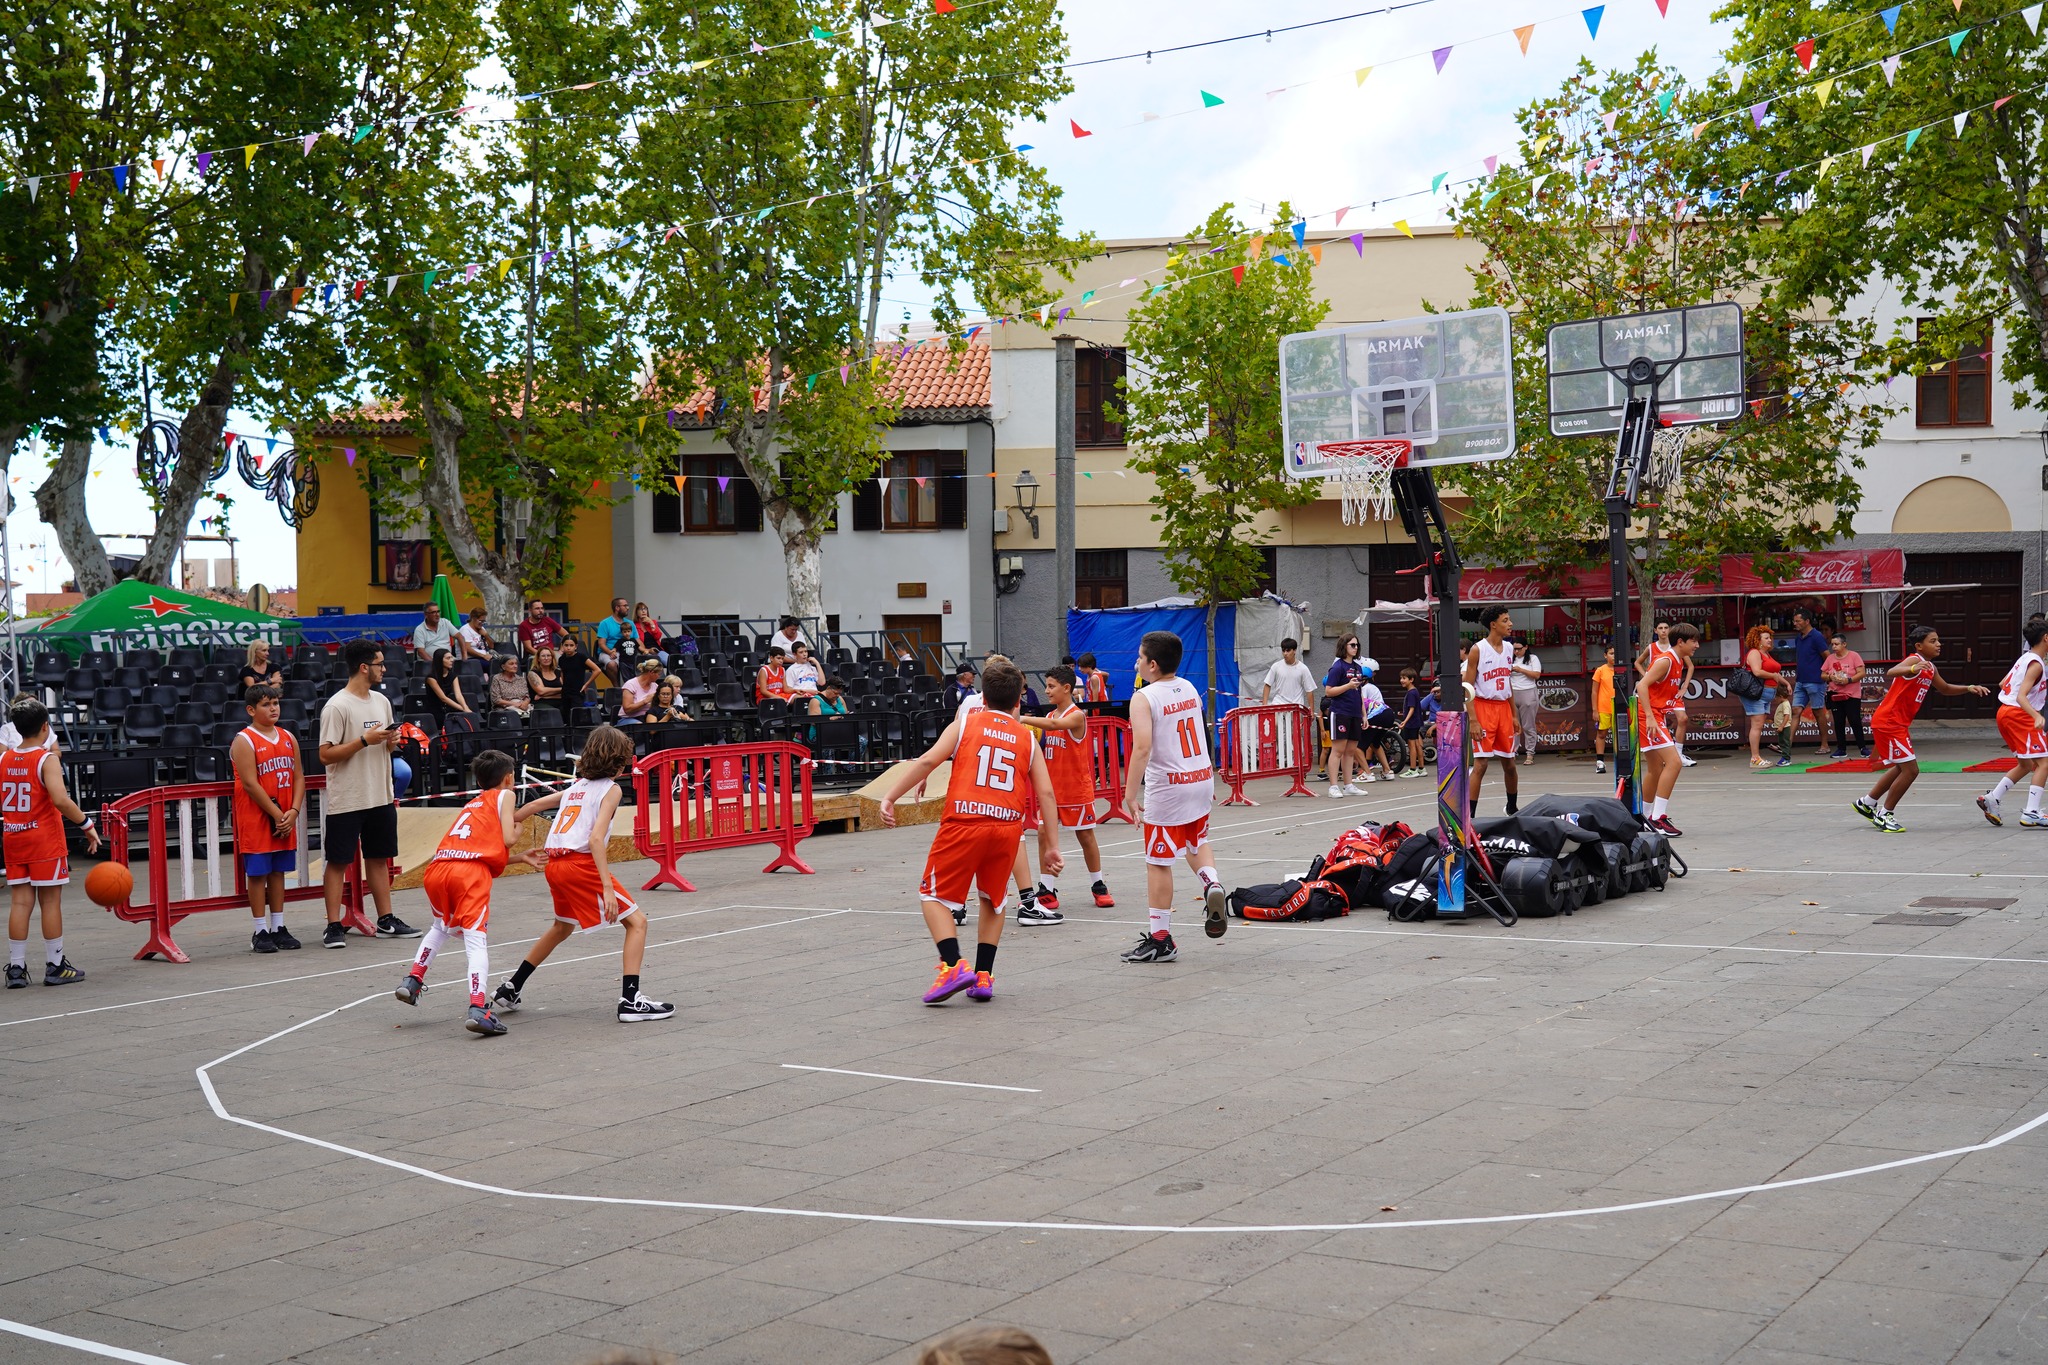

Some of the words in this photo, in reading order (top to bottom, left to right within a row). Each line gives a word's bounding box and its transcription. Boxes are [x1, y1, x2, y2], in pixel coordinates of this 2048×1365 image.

[1358, 335, 1424, 355] TARMAK
[1465, 440, 1483, 448] B900
[1484, 437, 1502, 447] BOX
[1654, 607, 1714, 618] INCHITOS
[90, 619, 283, 655] Heineken
[1495, 678, 1505, 691] 15
[1536, 679, 1567, 687] CARNE
[983, 727, 1017, 744] MAURO
[1176, 716, 1202, 758] 11
[1536, 733, 1580, 742] NCHITOS
[1686, 731, 1739, 741] PINCHITOS
[7, 767, 29, 776] YULIAN
[976, 744, 1016, 792] 15
[276, 771, 291, 788] 22
[2, 782, 32, 812] 26
[568, 791, 587, 800] OLIVER
[449, 812, 472, 839] 4
[553, 804, 583, 834] 17
